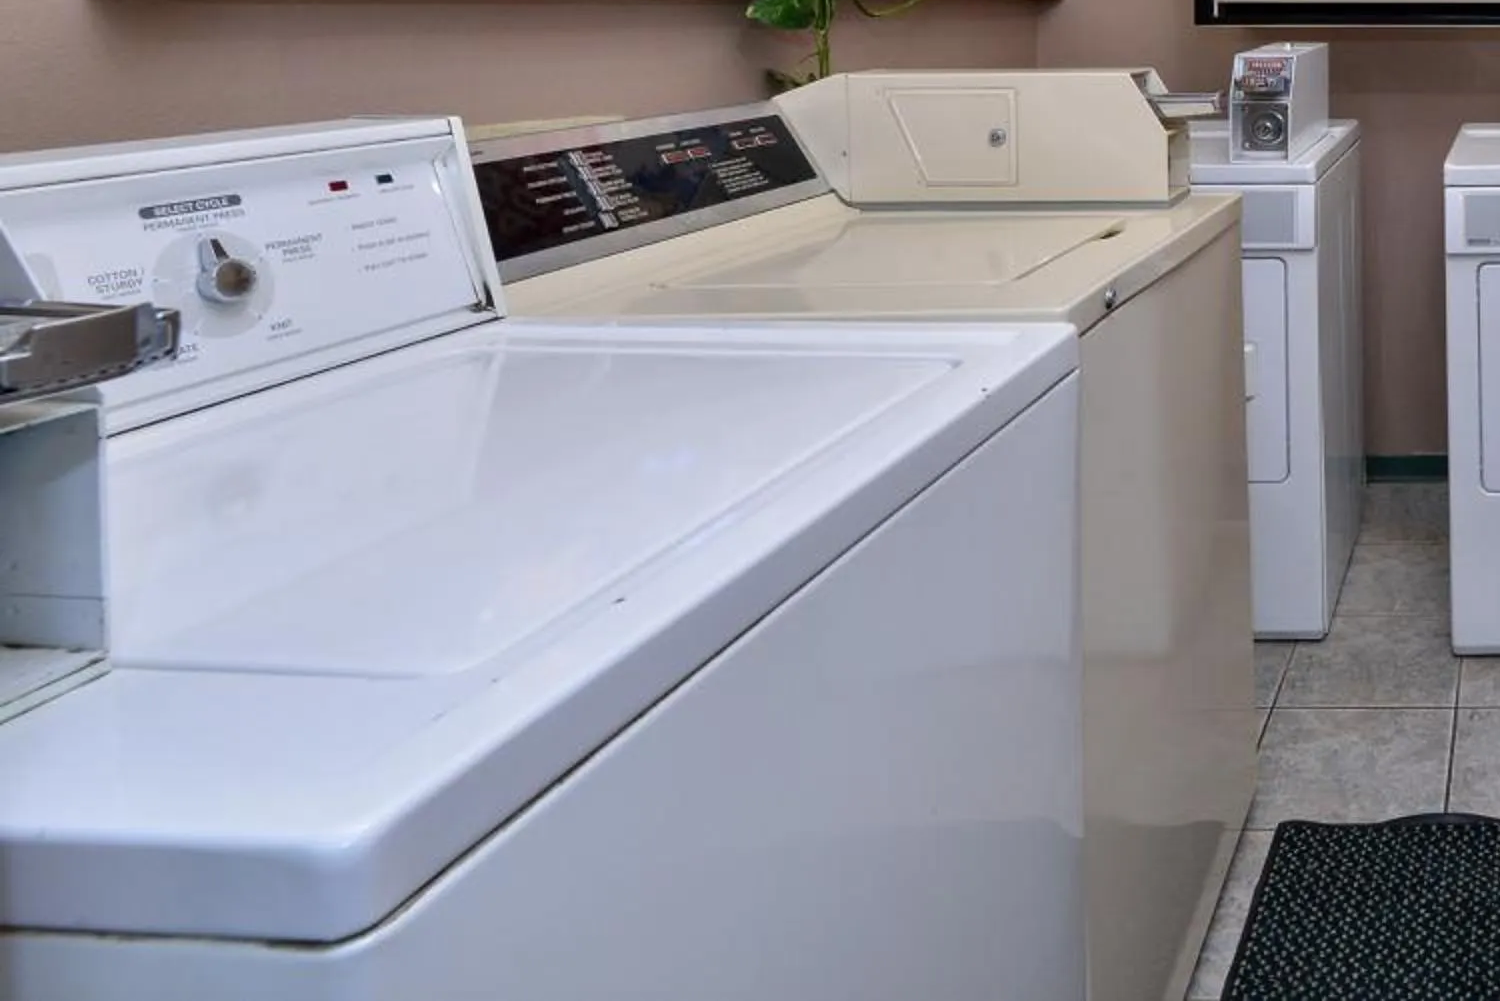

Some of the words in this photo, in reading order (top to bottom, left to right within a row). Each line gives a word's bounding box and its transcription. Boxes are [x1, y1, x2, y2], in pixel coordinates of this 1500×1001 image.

[153, 199, 195, 217] SELECT
[196, 196, 229, 211] CYCLE
[143, 213, 209, 231] PERMANENT
[213, 207, 246, 220] PRESS
[87, 268, 138, 286] COTTON
[95, 277, 143, 294] STURDY
